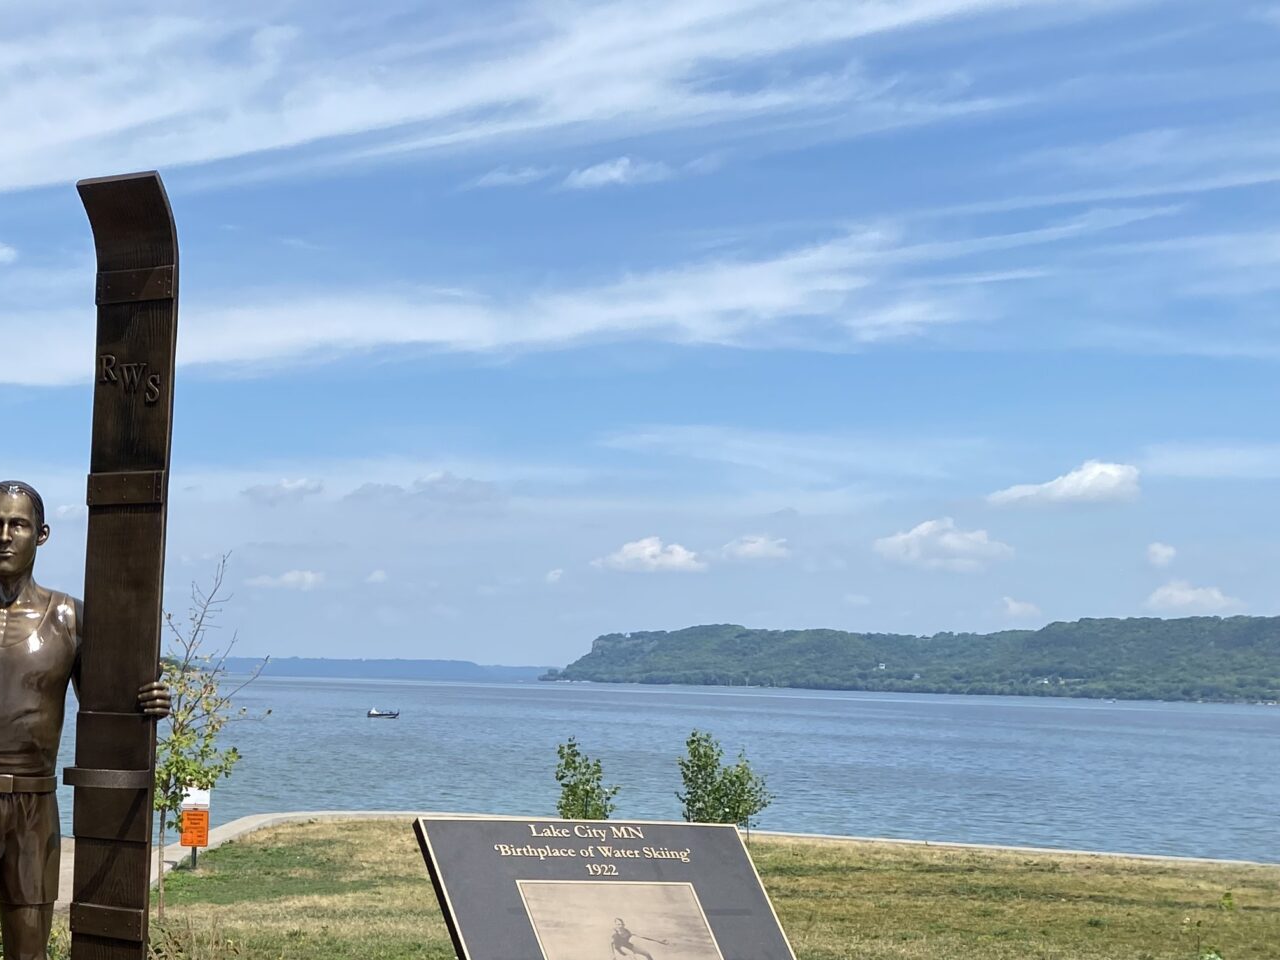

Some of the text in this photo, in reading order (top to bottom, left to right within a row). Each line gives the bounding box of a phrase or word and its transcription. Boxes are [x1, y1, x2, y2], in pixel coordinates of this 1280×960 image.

[100, 354, 160, 402] RWS
[528, 824, 644, 841] Lake City MN
[580, 846, 594, 857] of
[597, 846, 641, 858] Water
[586, 864, 618, 875] 1922
